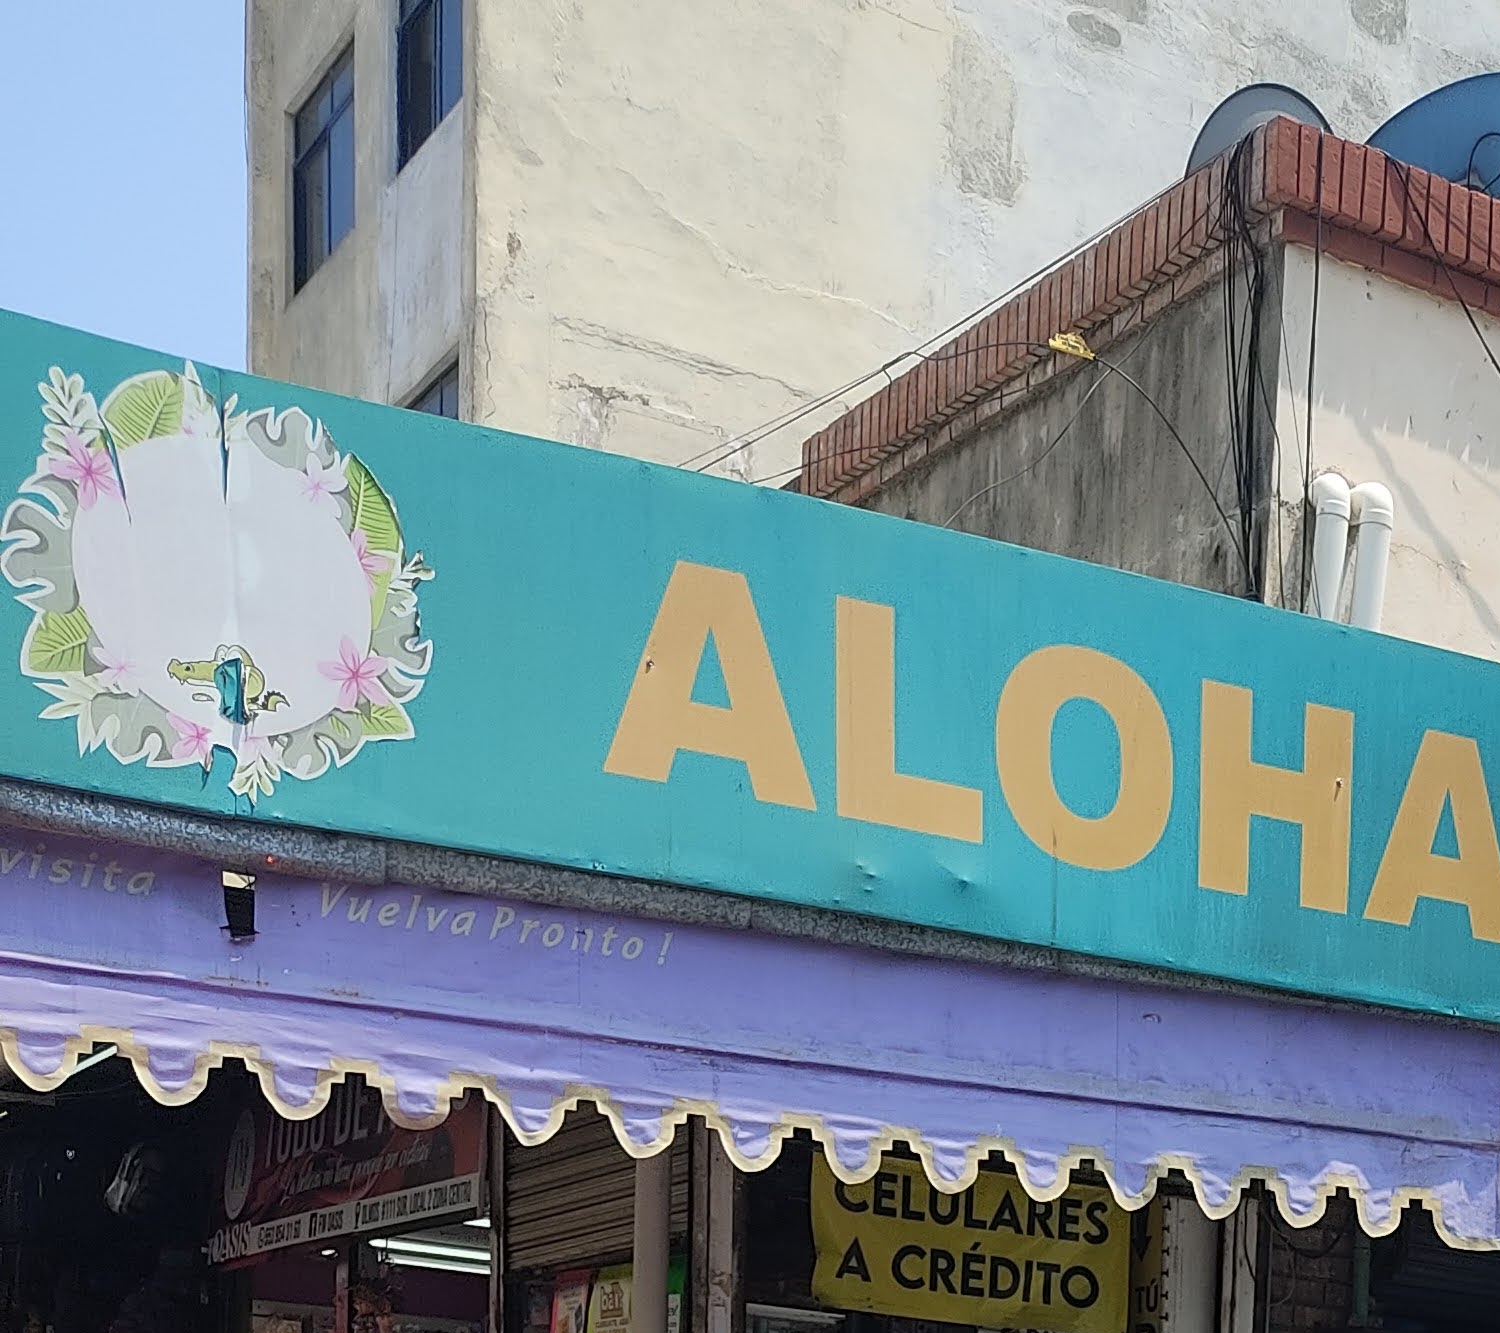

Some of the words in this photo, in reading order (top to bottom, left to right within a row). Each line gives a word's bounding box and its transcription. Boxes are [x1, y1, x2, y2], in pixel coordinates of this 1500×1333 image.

[319, 882, 475, 938] Vuelva
[488, 906, 645, 960] Pronto
[212, 1220, 252, 1262] OASIS
[834, 1171, 1109, 1245] CELULARES
[835, 1236, 872, 1283] A
[891, 1241, 1099, 1309] CRÉDITO
